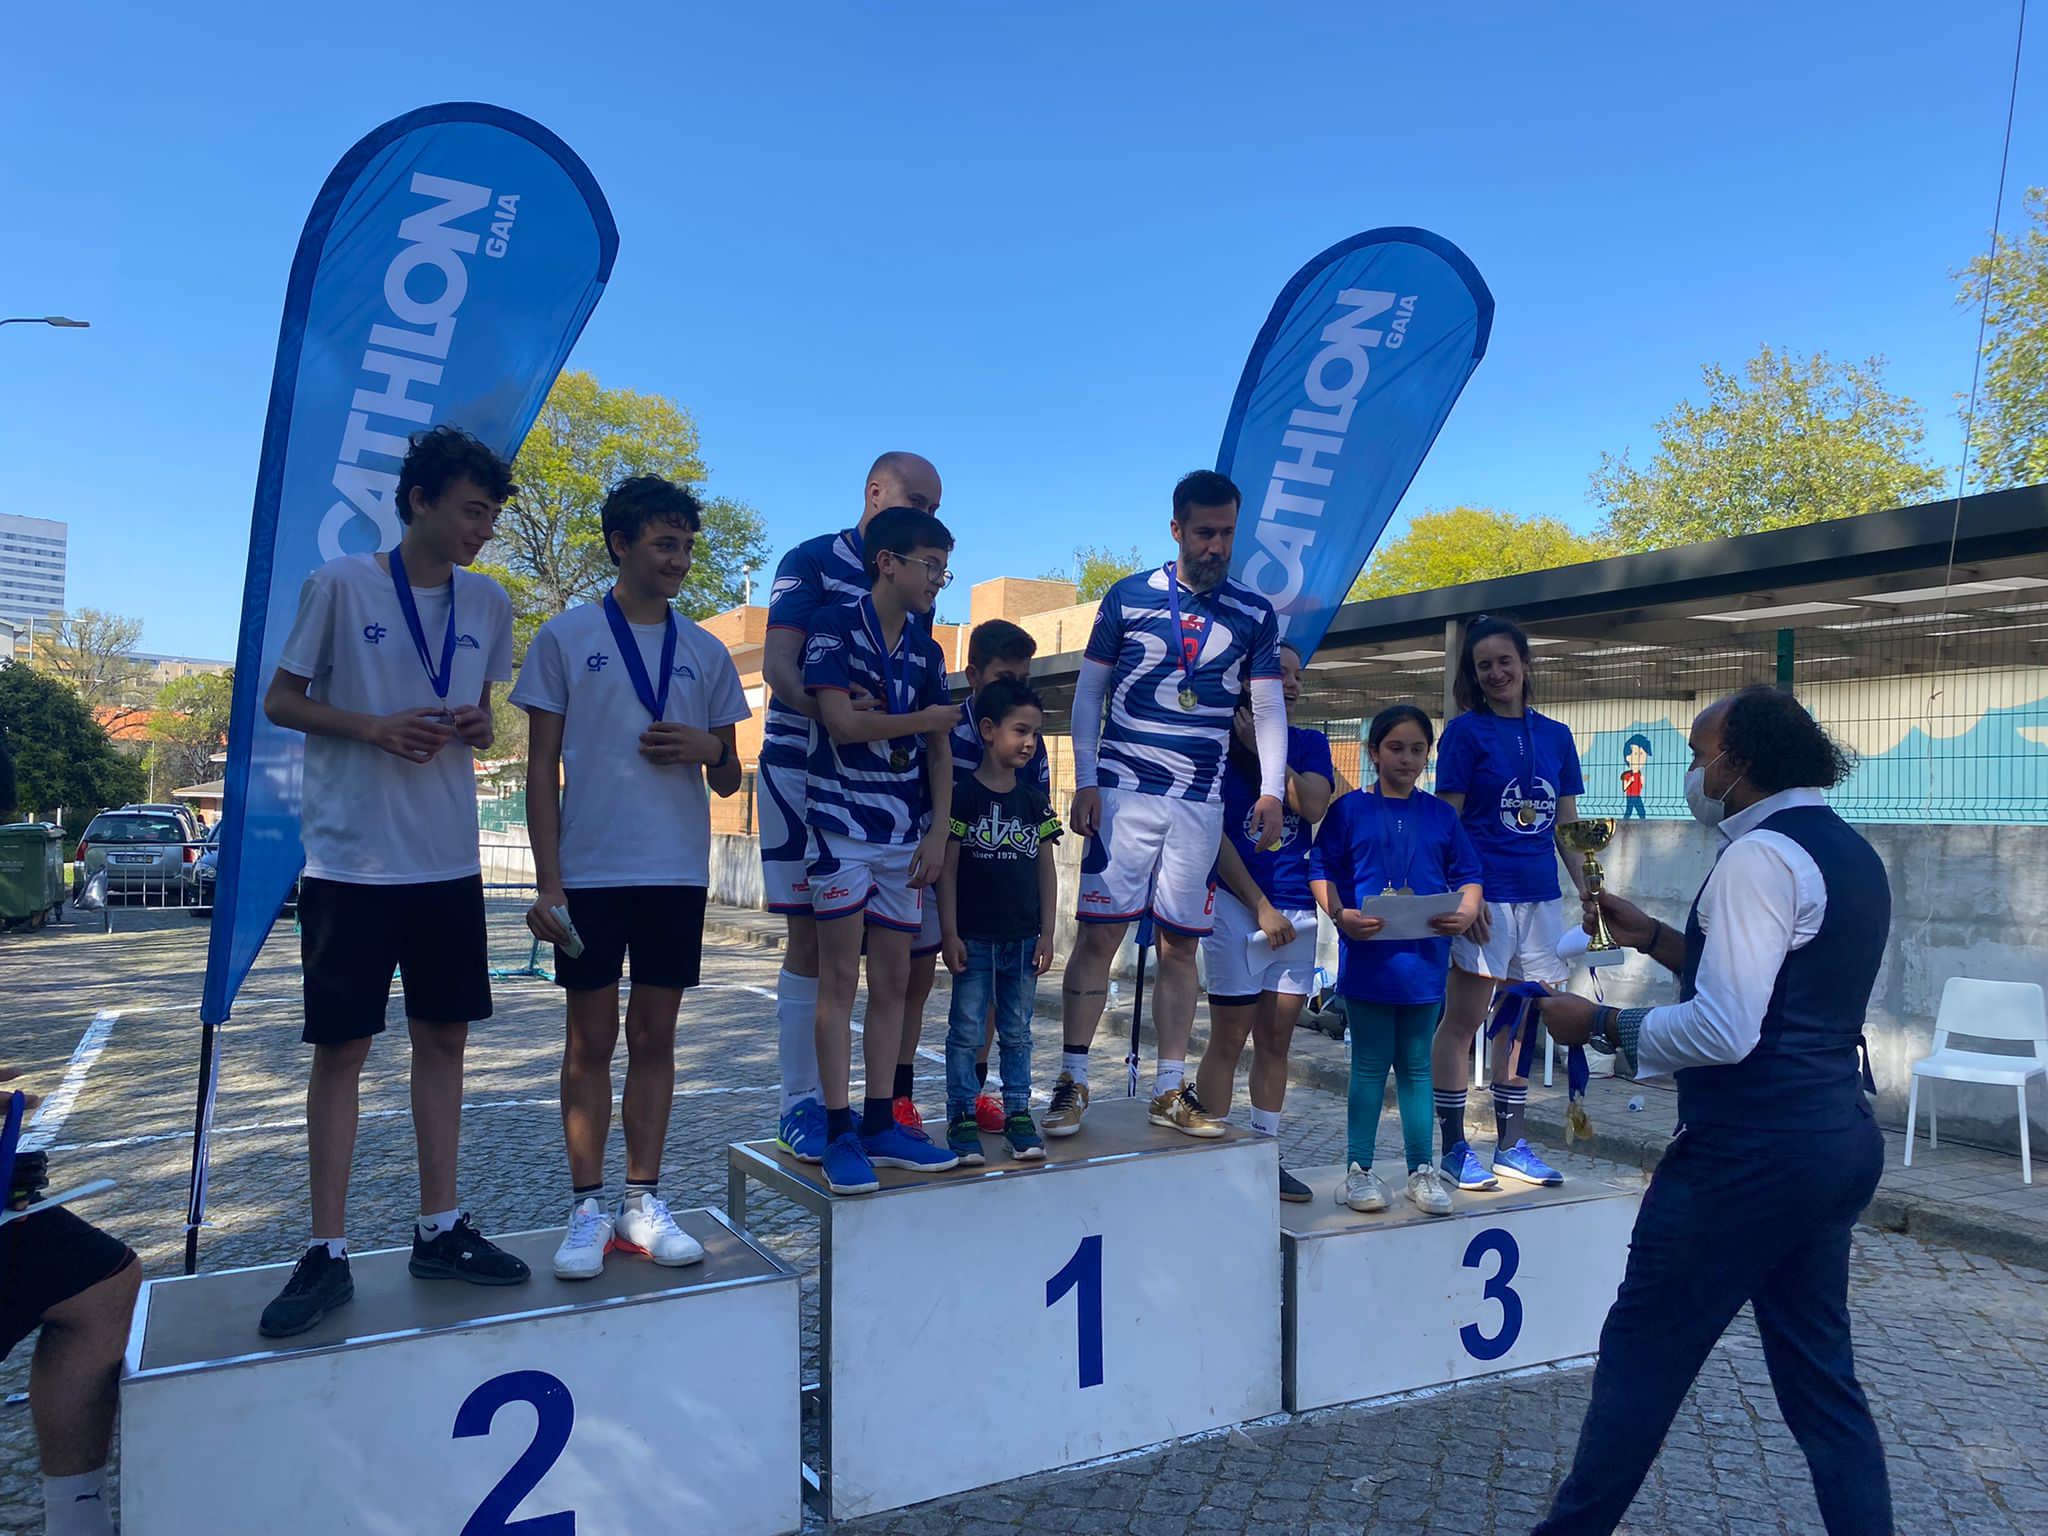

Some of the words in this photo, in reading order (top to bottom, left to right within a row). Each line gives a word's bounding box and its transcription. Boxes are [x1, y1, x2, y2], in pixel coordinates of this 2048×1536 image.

[485, 195, 520, 258] GAIA
[1385, 294, 1418, 349] GAIA
[1241, 288, 1396, 637] CATHLON
[1046, 1234, 1104, 1389] 1
[1459, 1228, 1523, 1361] 3
[452, 1369, 576, 1536] 2
